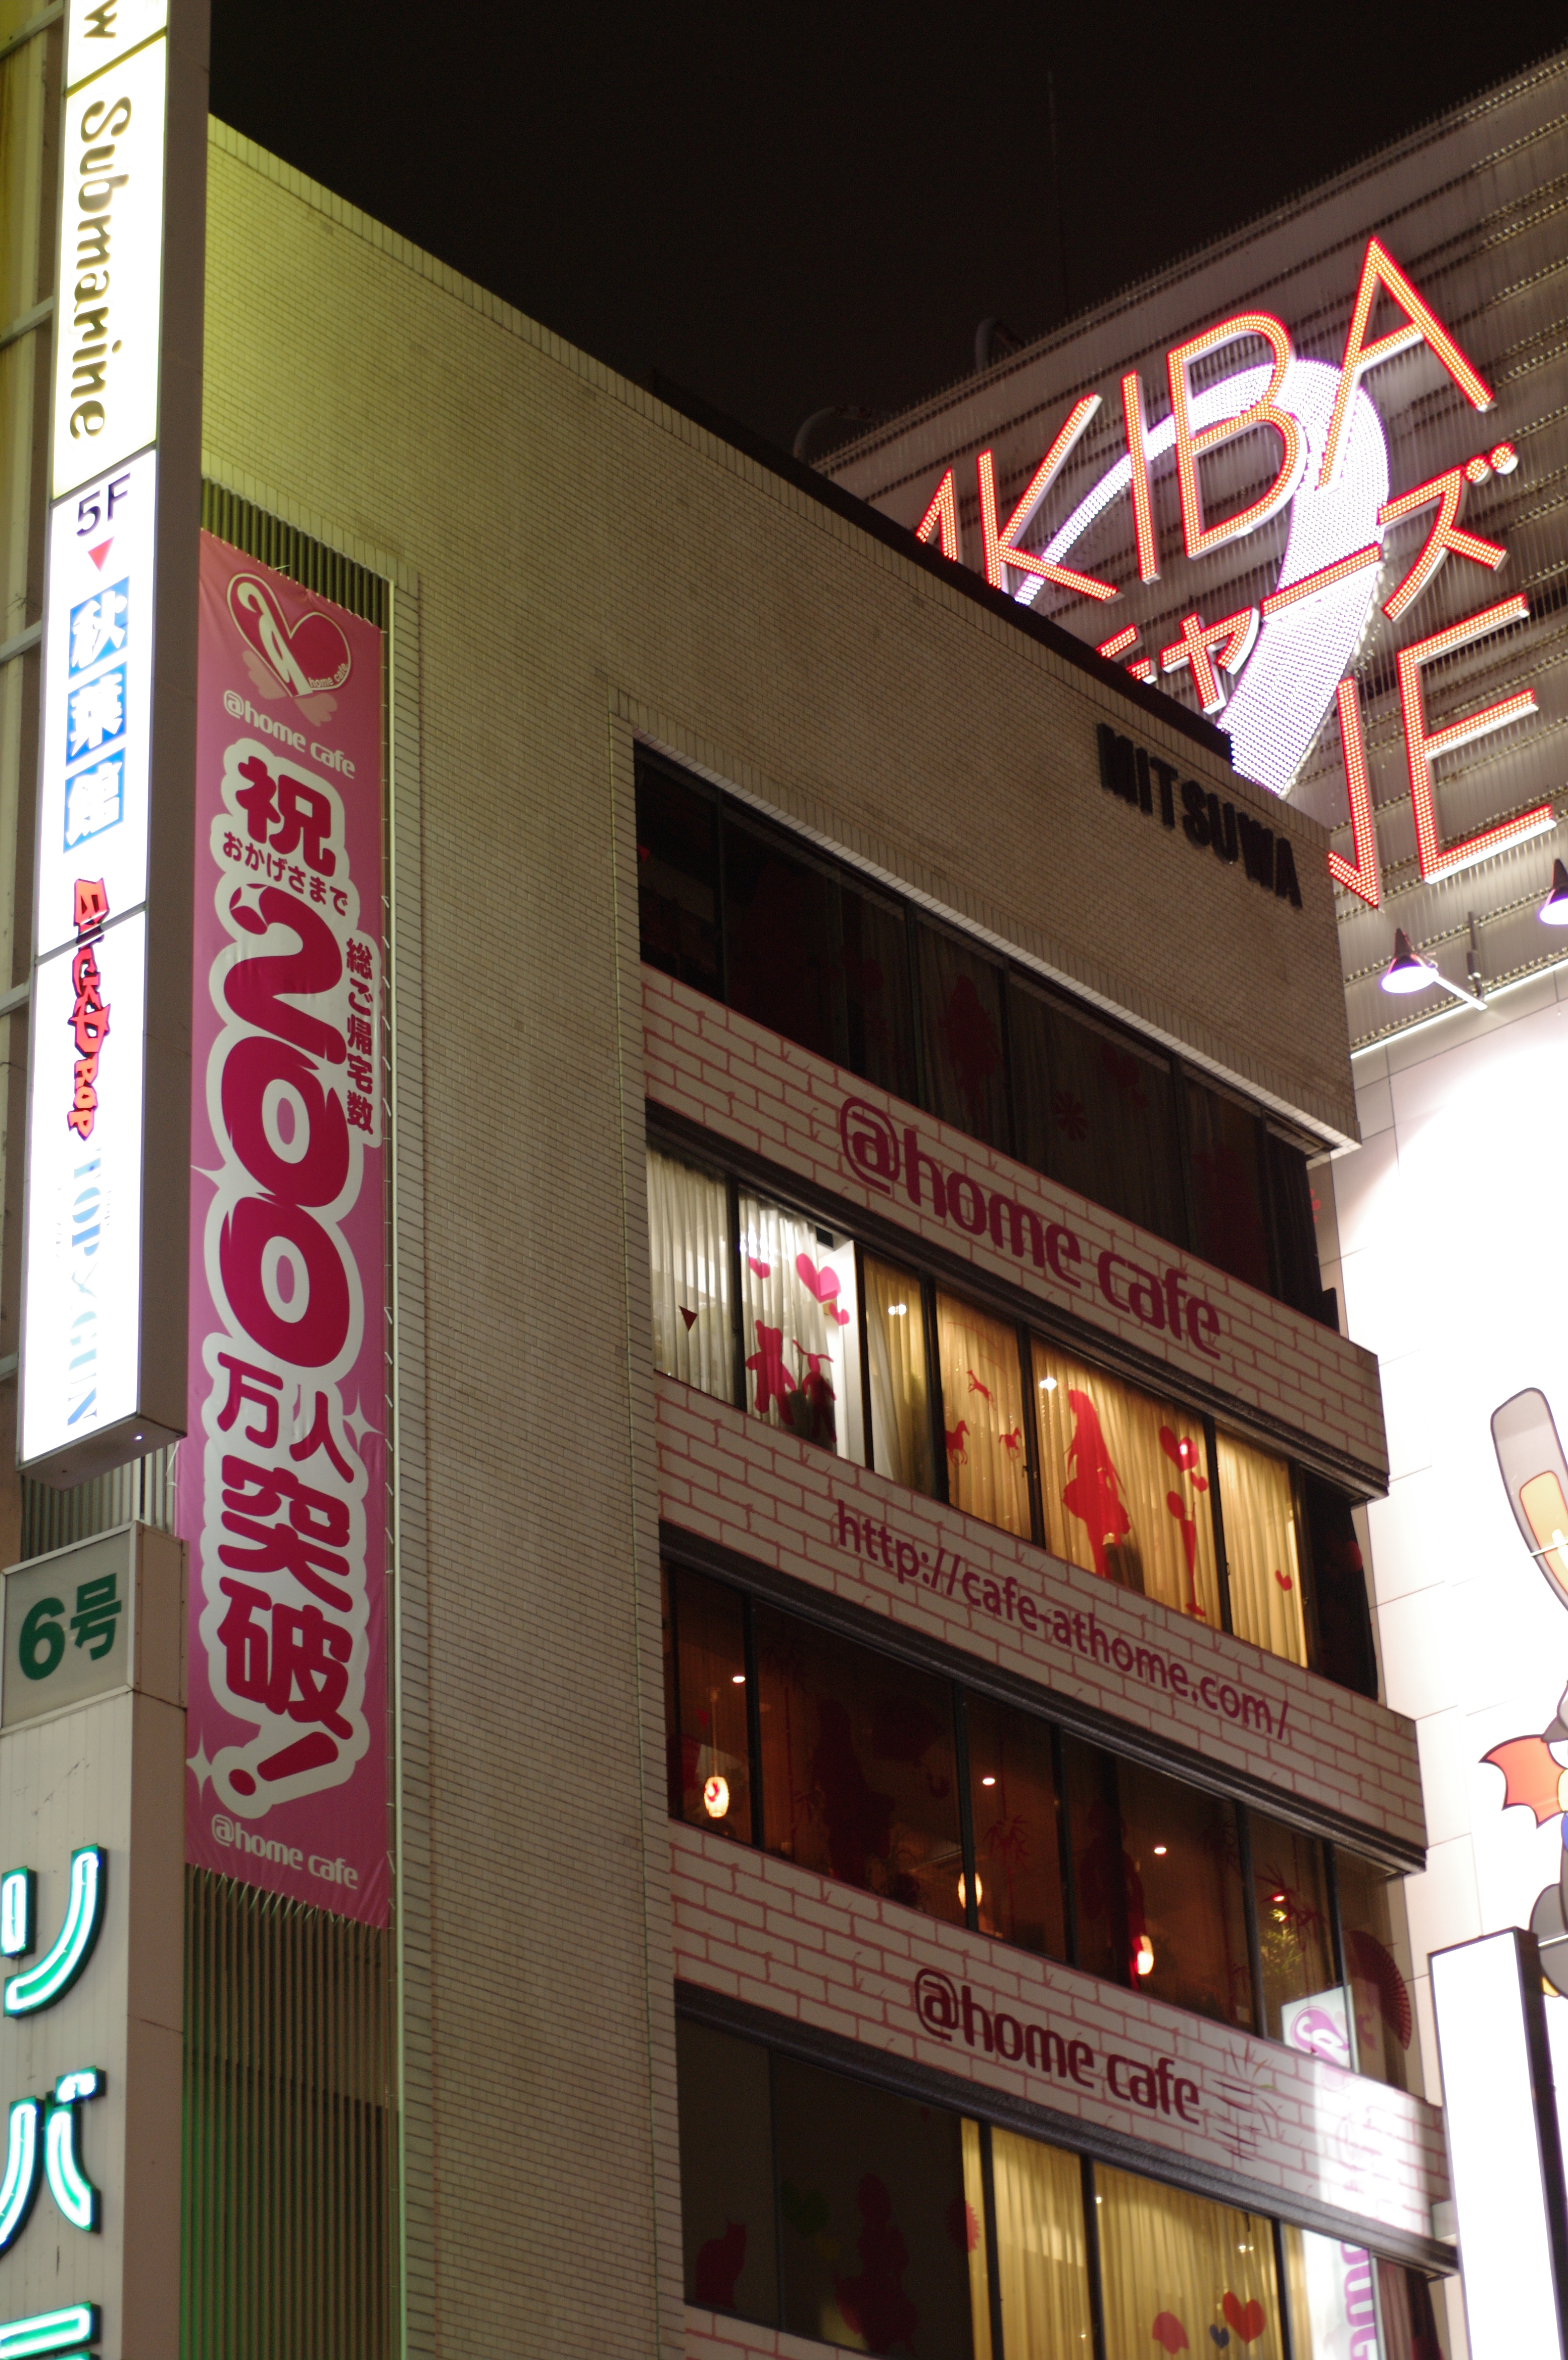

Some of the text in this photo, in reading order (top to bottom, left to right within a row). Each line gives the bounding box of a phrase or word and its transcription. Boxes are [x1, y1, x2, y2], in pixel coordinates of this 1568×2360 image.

[70, 96, 131, 440] Submarine
[76, 472, 131, 537] 5F
[224, 689, 356, 779] @home cafe
[223, 831, 348, 915] おかげさまで
[236, 755, 336, 877] 祝
[1097, 722, 1302, 909] MITSUWA
[346, 937, 373, 1135] 総ご帰宅数
[840, 1097, 1220, 1361] @home cafe
[19, 1572, 122, 1681] 6号
[838, 1499, 1289, 1741] http://cafe-athome.com/
[211, 1813, 359, 1890] @home cafe
[914, 1968, 1200, 2125] @home cafe
